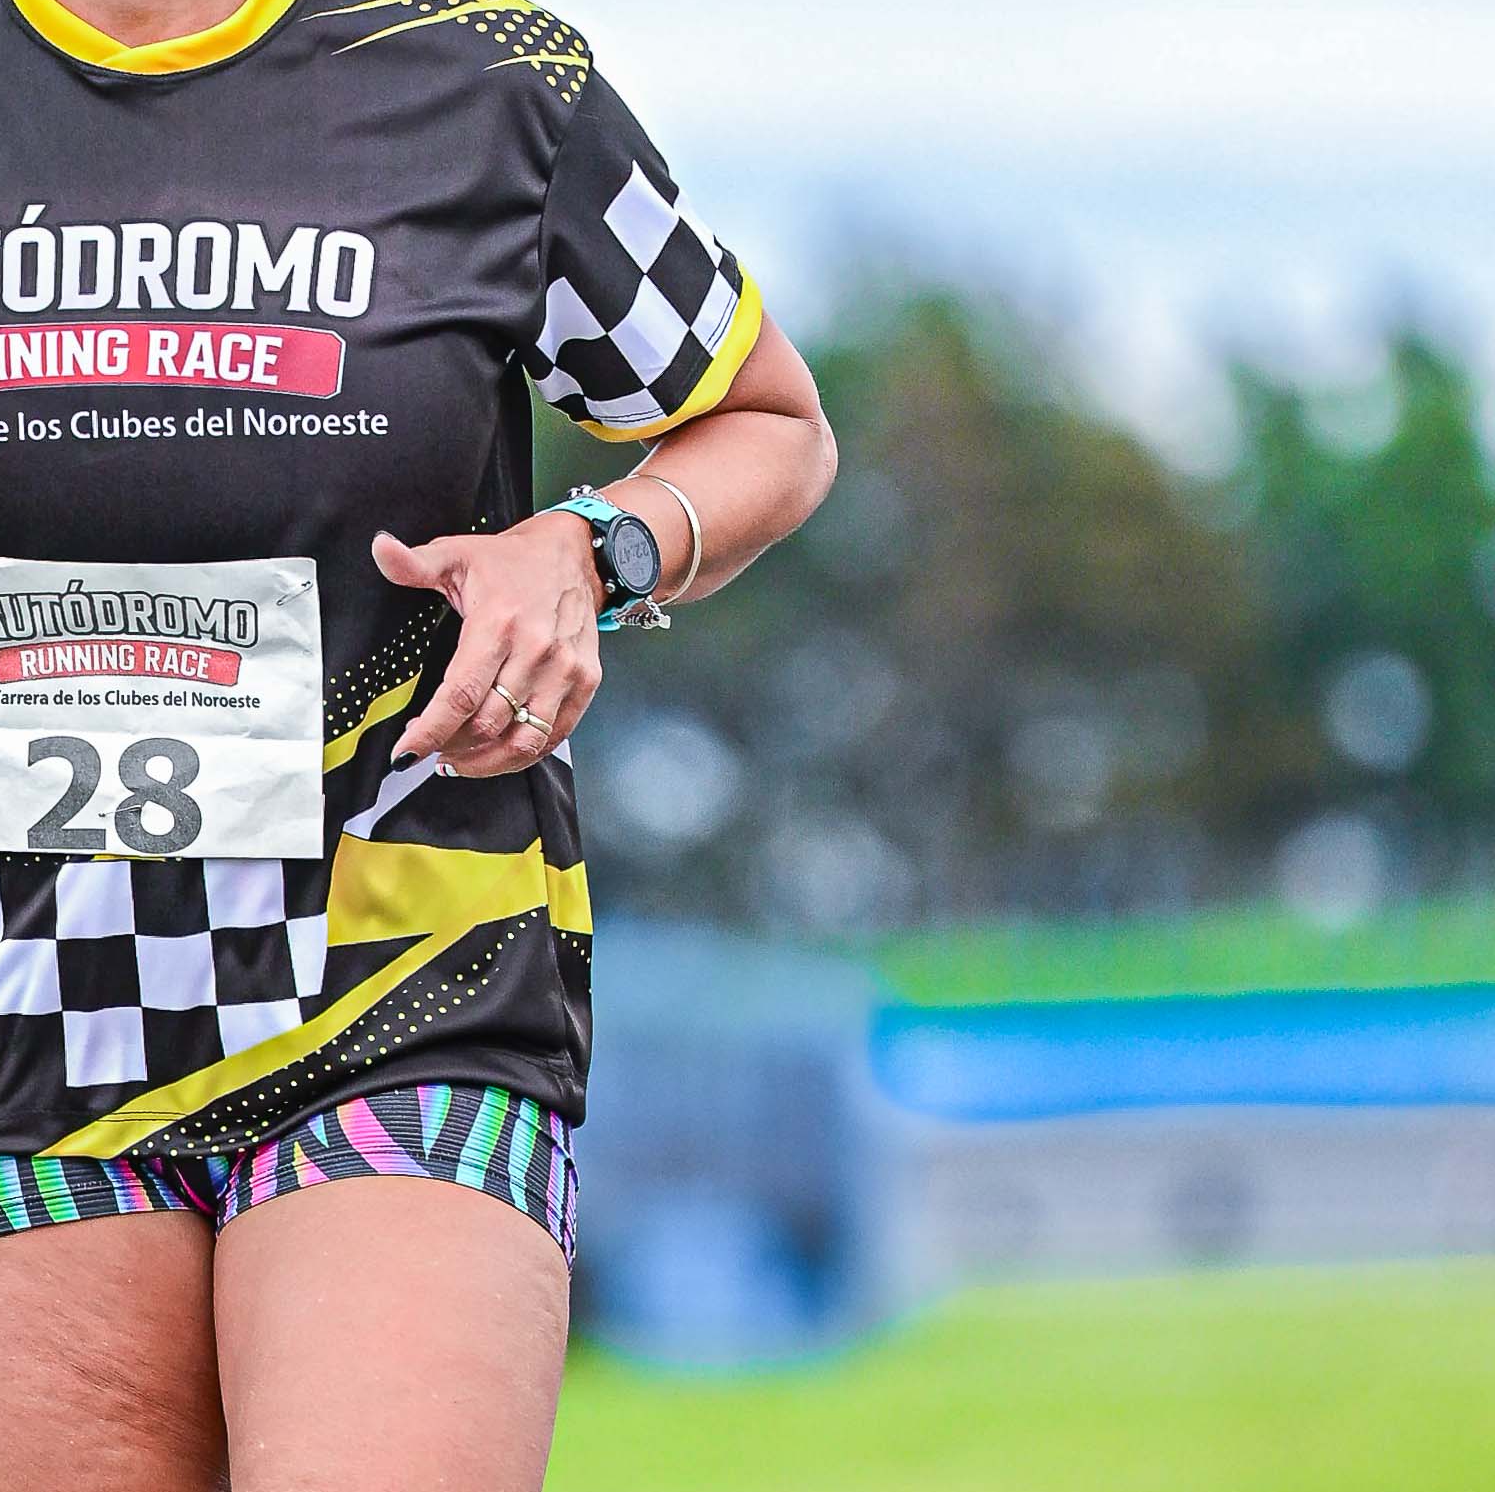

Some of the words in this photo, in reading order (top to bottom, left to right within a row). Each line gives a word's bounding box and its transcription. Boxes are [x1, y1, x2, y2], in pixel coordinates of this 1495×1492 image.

[146, 329, 284, 386] RACE
[18, 410, 62, 441] los
[70, 410, 176, 440] Clubes
[185, 408, 234, 437] del
[243, 407, 389, 437] Noroeste
[20, 643, 136, 677] RUNNING
[145, 646, 212, 680] RACE
[53, 690, 74, 706] de
[77, 690, 101, 706] los
[105, 690, 160, 707] Clubes
[164, 691, 188, 707] del
[192, 692, 261, 709] Noroeste
[27, 735, 203, 854] 28
